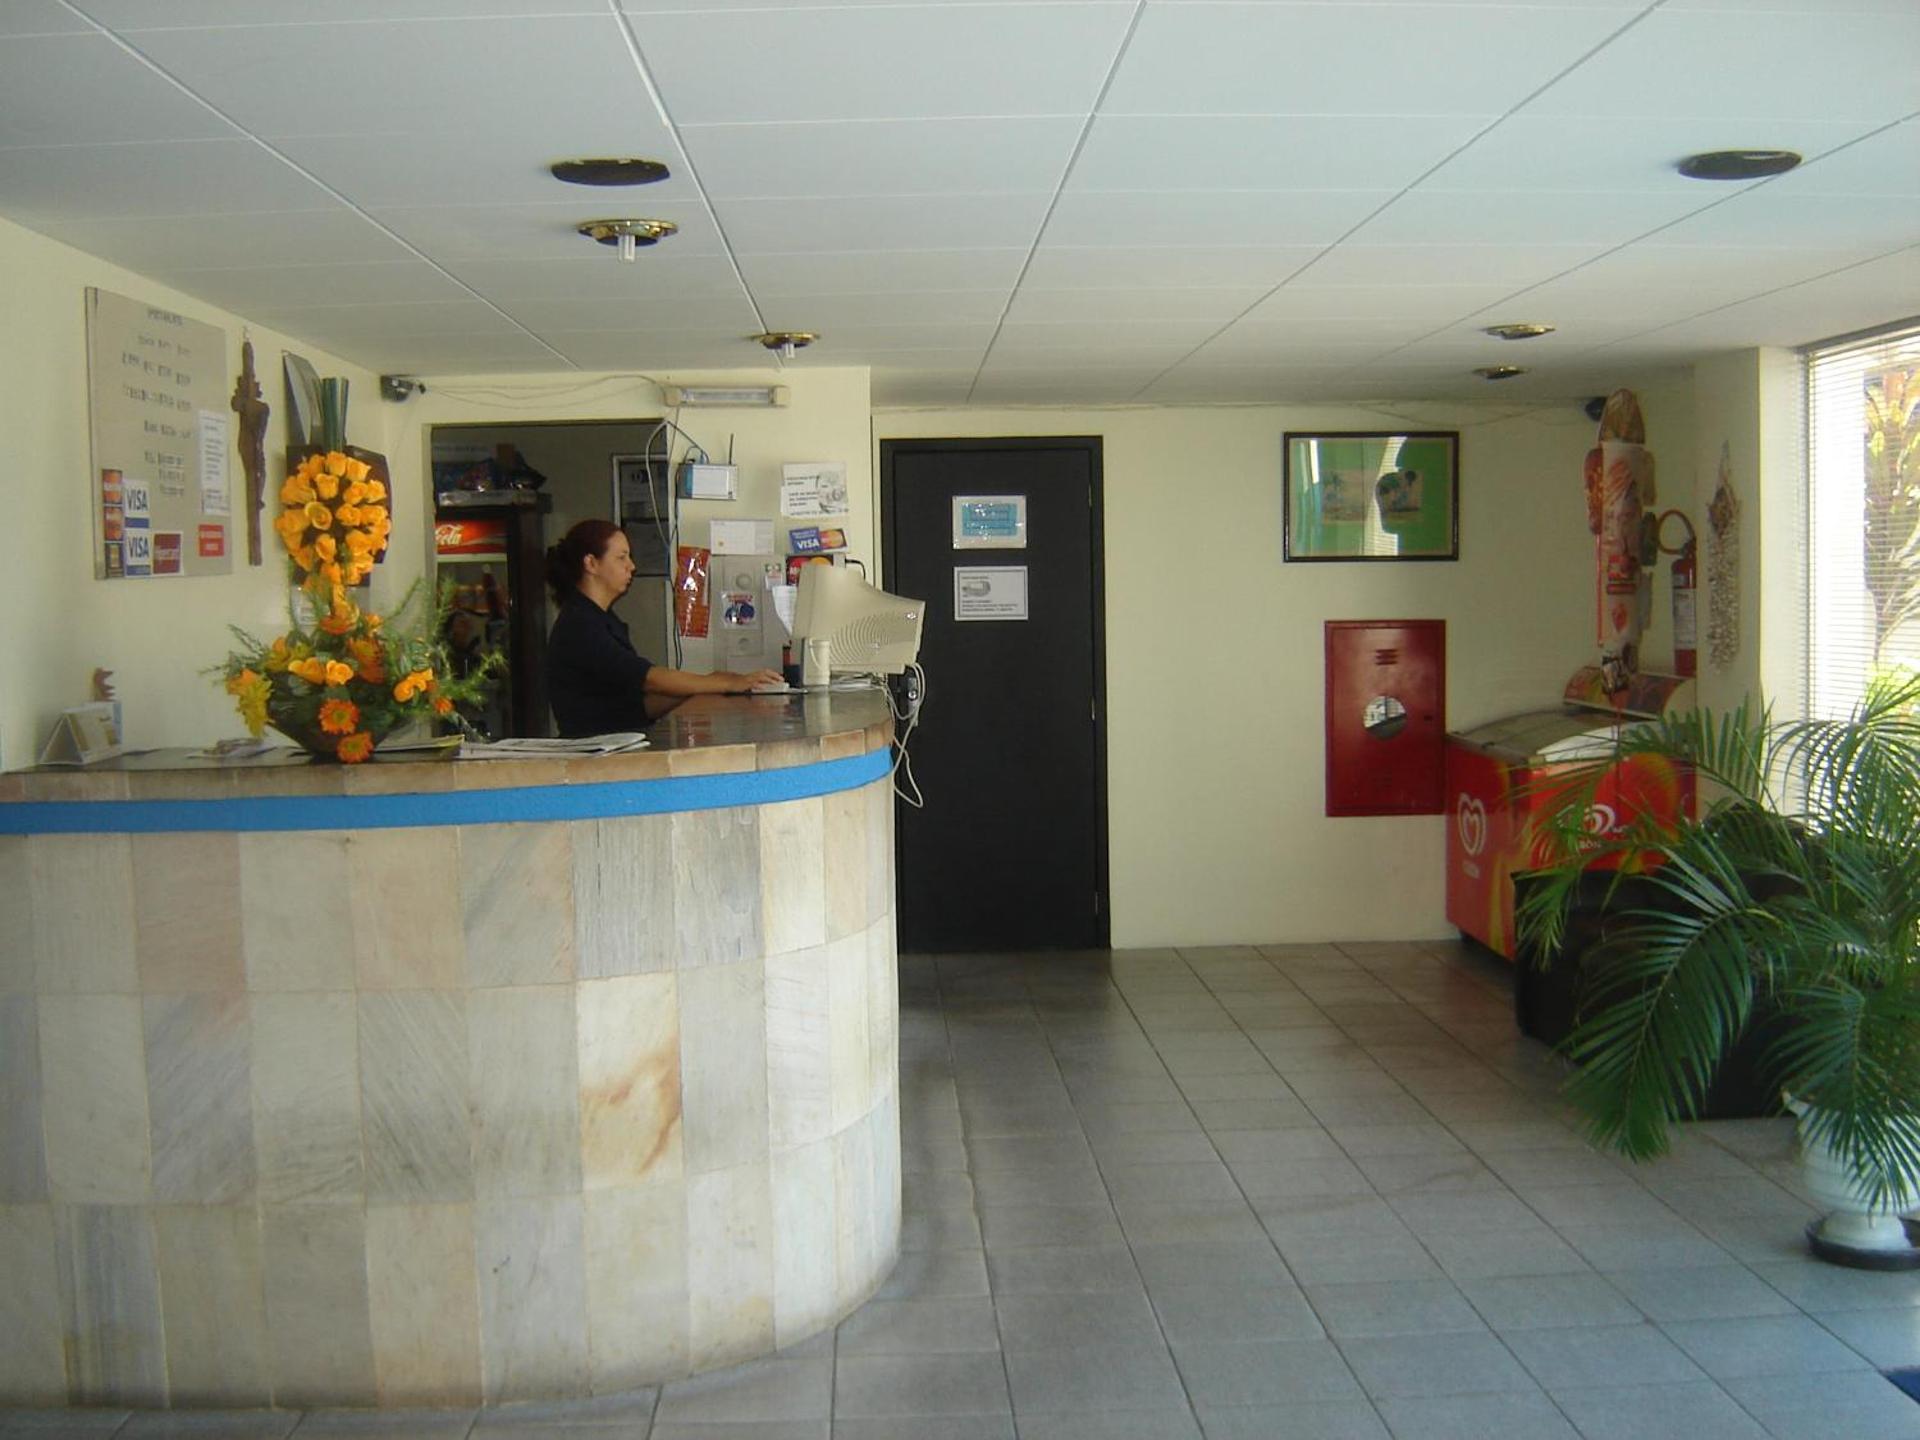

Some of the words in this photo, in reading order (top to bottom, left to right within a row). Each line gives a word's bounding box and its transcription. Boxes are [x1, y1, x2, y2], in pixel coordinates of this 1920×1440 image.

[126, 489, 148, 511] VISA
[128, 536, 150, 558] VISA
[797, 538, 820, 549] VISA
